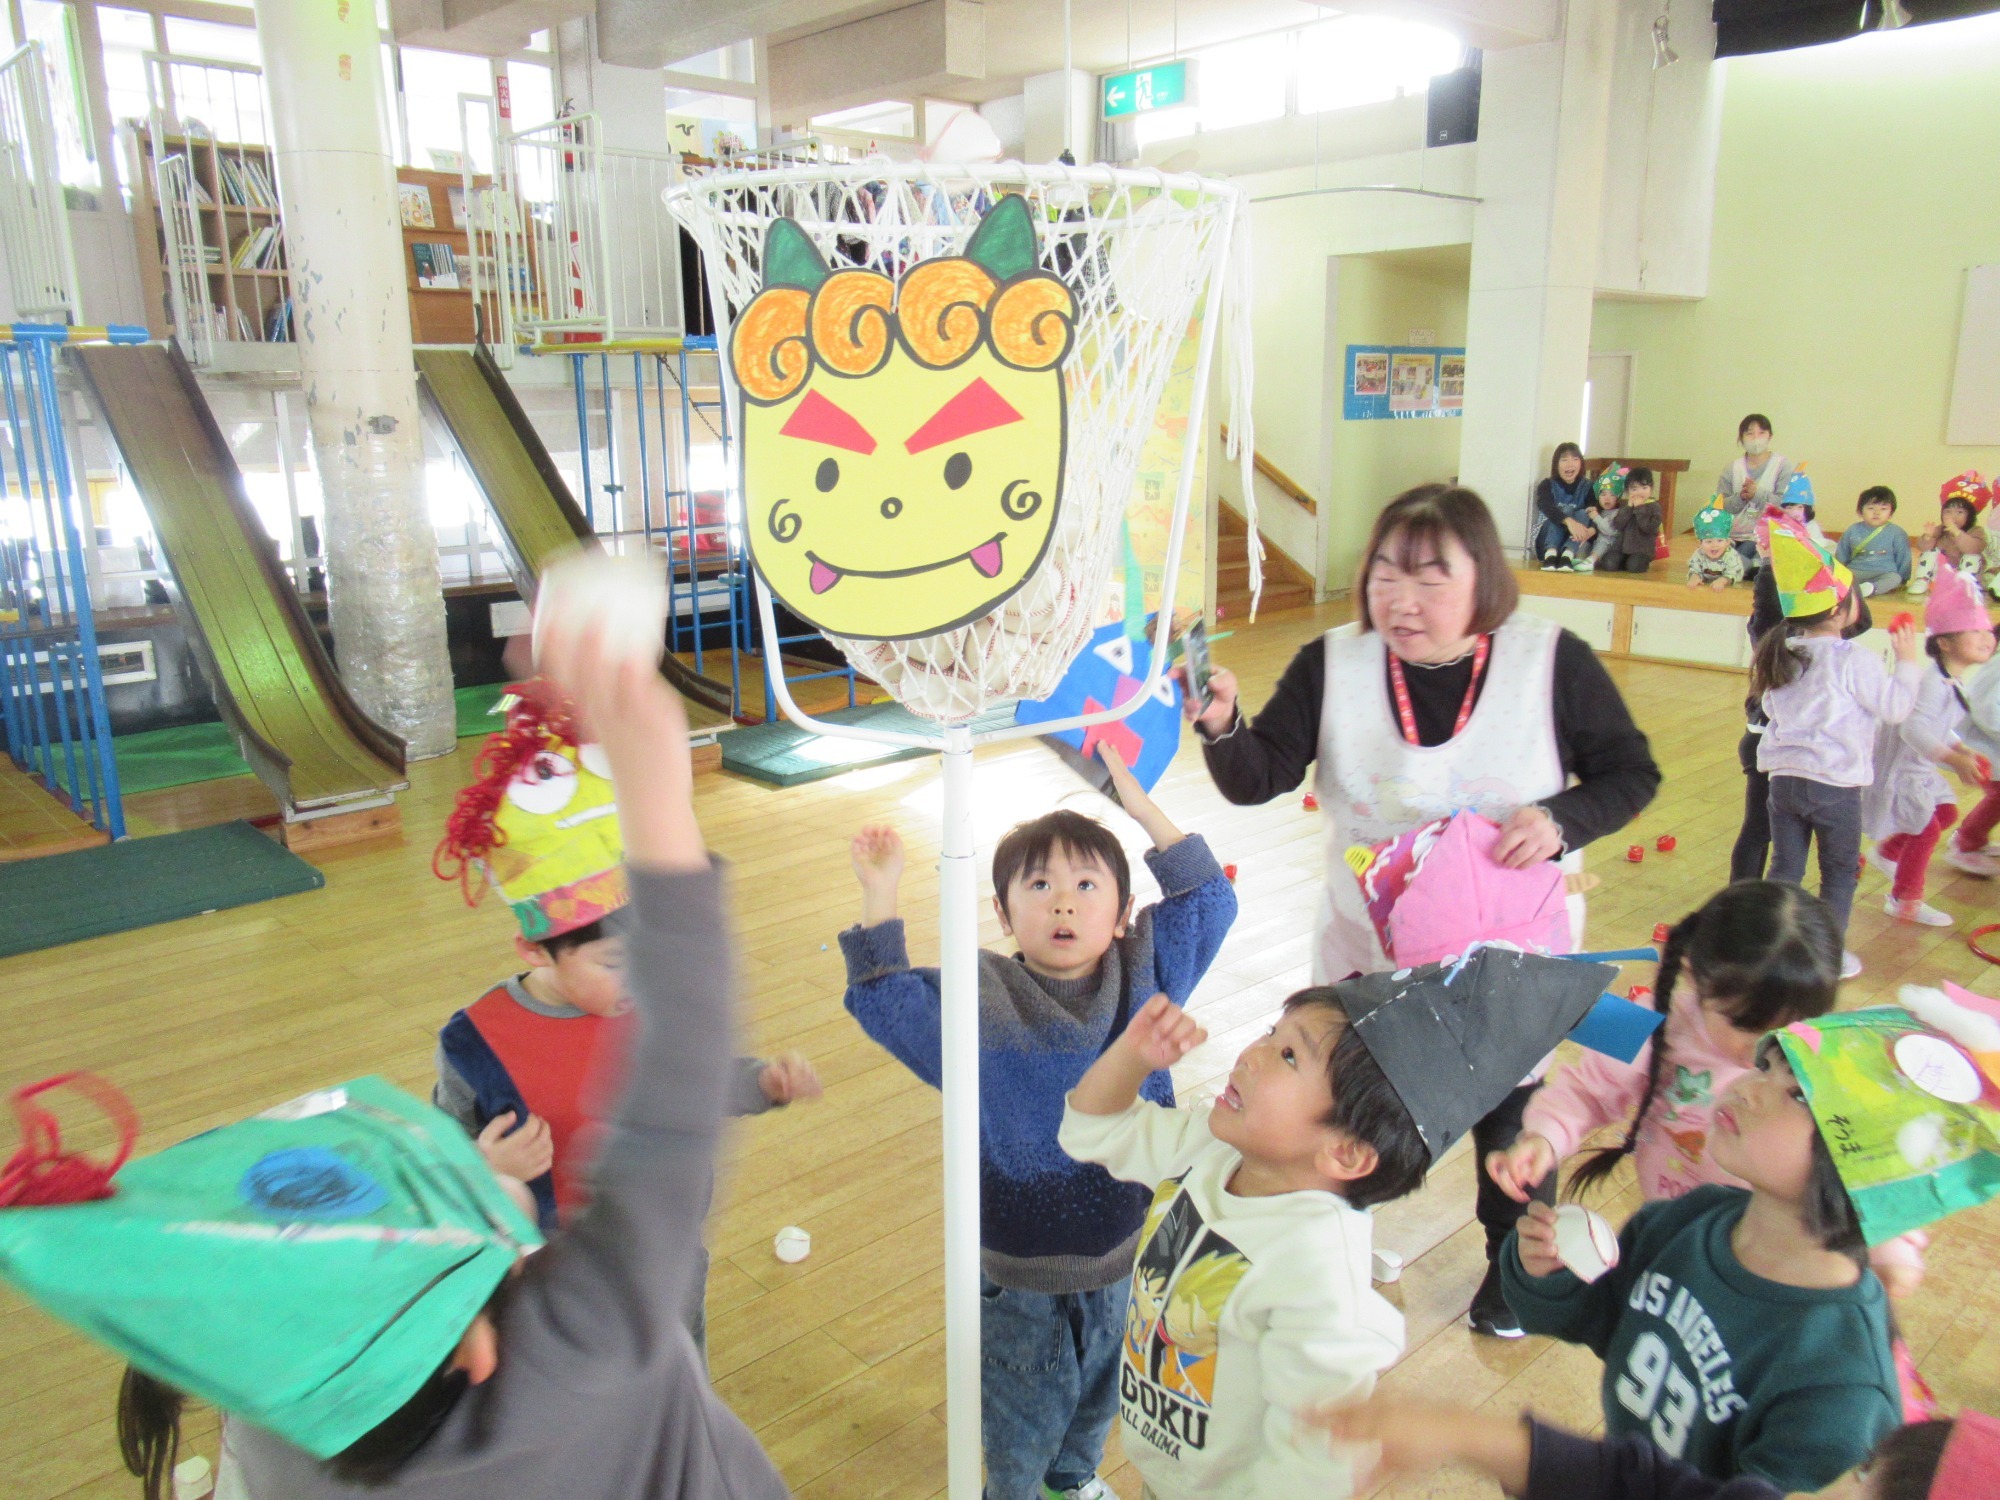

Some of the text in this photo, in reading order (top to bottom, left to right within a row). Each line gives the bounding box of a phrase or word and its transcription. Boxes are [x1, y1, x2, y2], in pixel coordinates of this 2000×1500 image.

[1121, 1361, 1209, 1450] GOKU
[1614, 1331, 1699, 1461] 93
[1140, 1421, 1181, 1461] DAIMA
